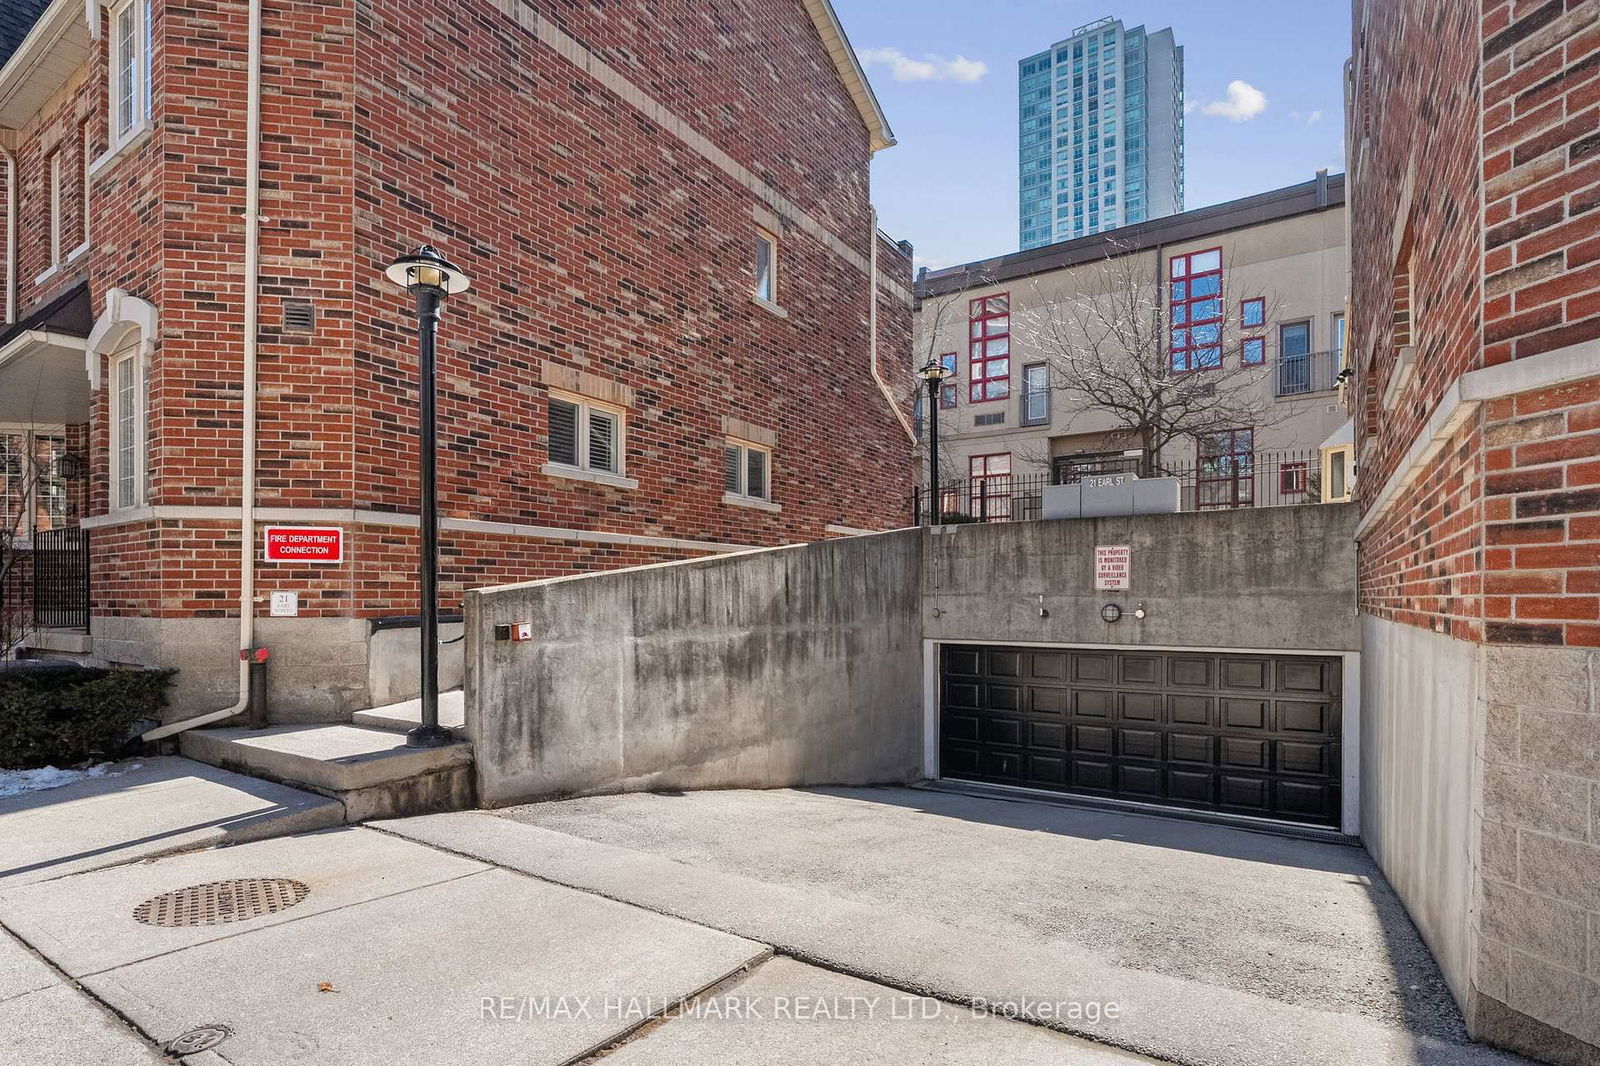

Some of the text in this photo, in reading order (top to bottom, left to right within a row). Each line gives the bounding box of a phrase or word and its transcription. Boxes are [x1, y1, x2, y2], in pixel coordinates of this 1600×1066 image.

[270, 535, 337, 543] FIRE DEPARTMENT
[280, 546, 328, 554] CONNECTION
[279, 594, 288, 602] 21
